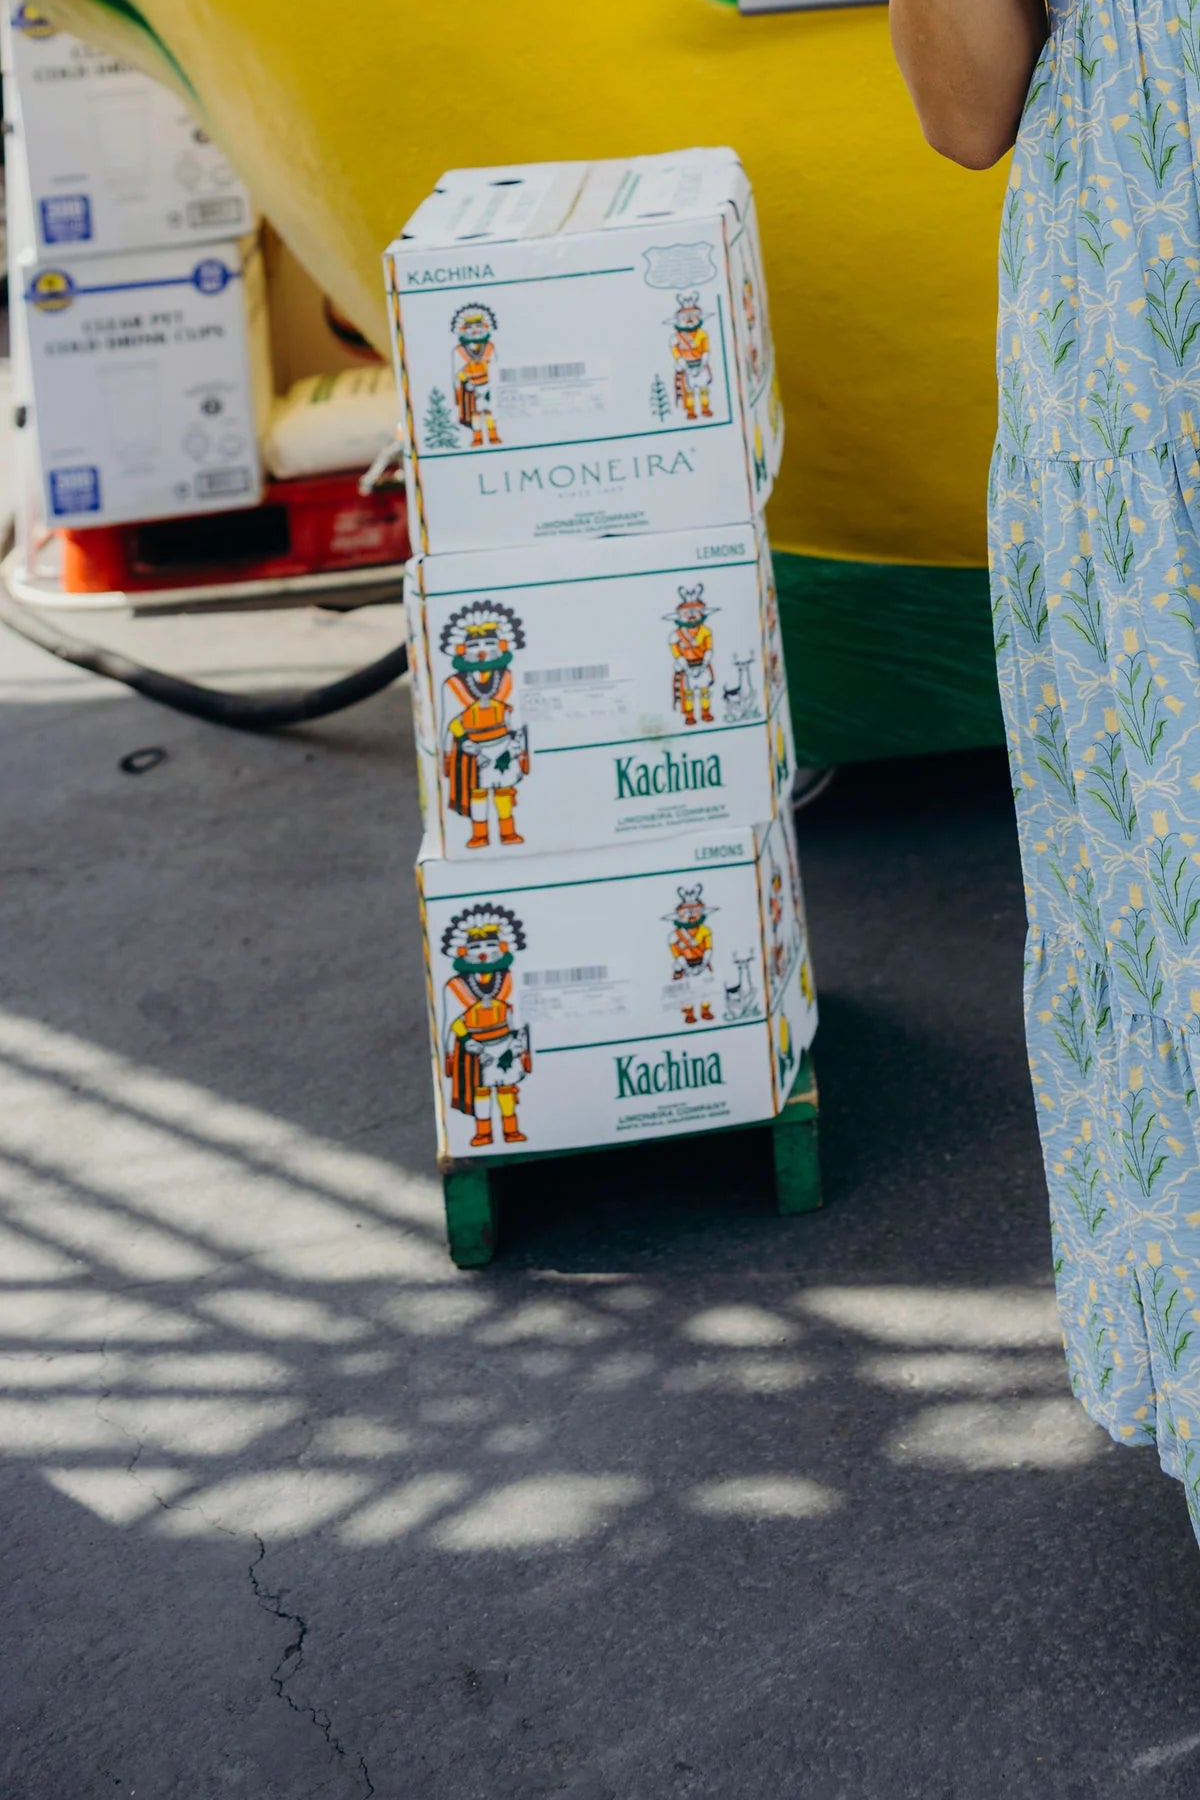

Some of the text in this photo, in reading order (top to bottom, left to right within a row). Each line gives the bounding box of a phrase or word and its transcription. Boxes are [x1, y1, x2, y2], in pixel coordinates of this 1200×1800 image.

[407, 264, 495, 286] KACHINA
[477, 449, 695, 495] LIMONEIRA
[696, 543, 746, 560] LEMONS
[612, 750, 724, 800] Kachina
[694, 843, 745, 861] LEMONS
[613, 1050, 725, 1100] Kachina
